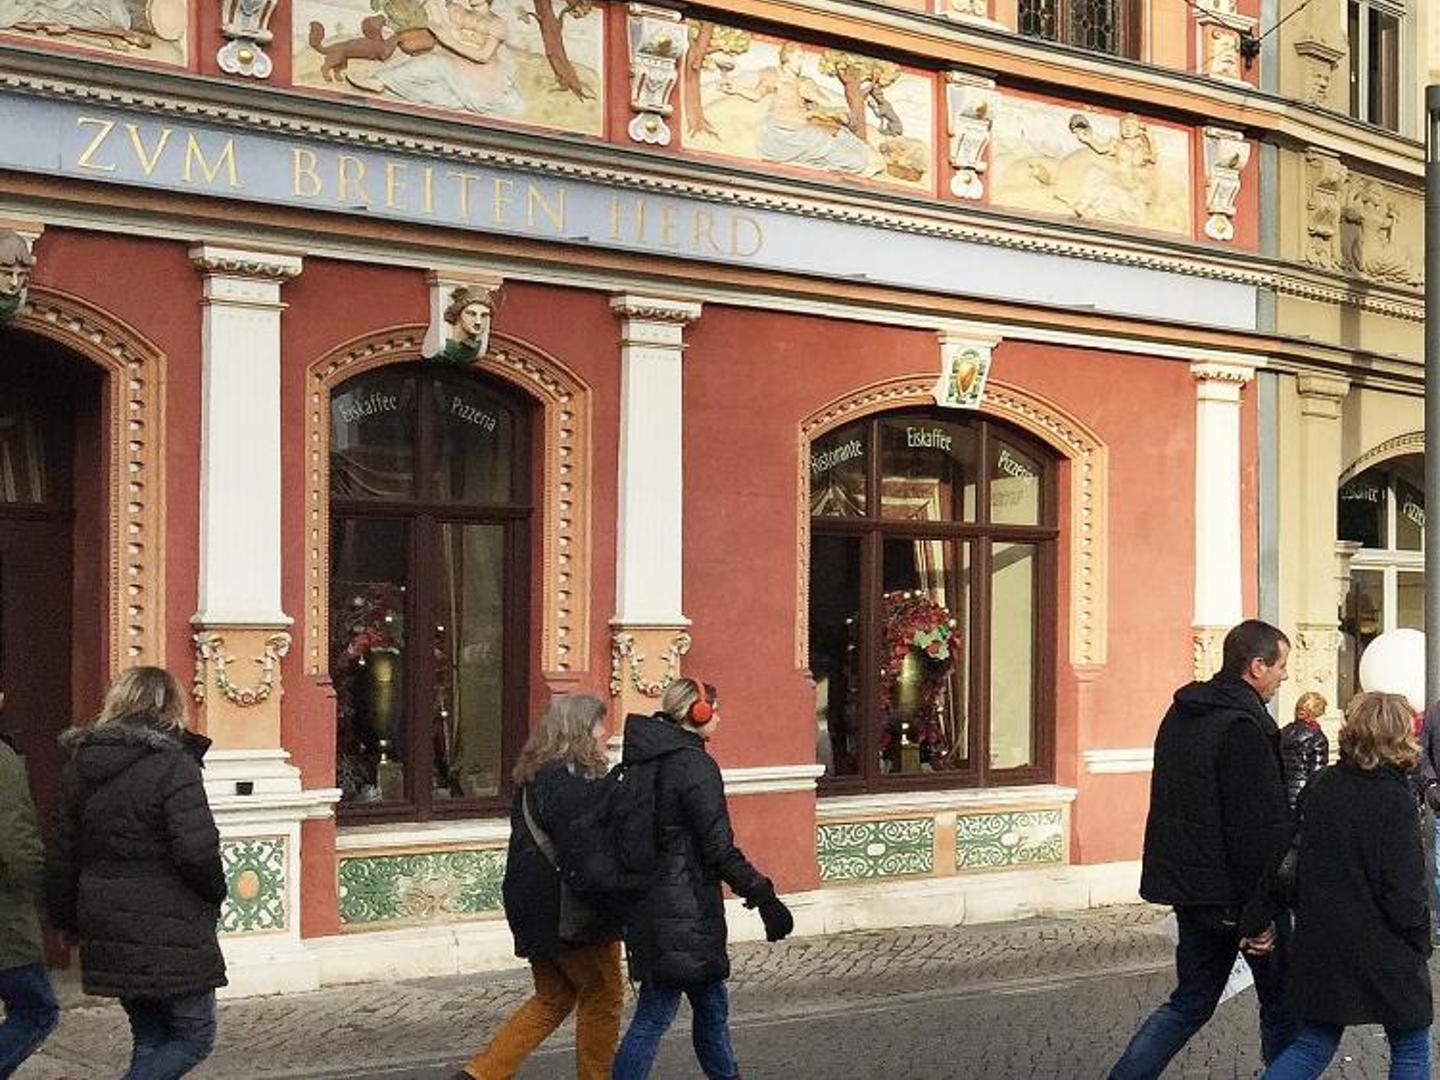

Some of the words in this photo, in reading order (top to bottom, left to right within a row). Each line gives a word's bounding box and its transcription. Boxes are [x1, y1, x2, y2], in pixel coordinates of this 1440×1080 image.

[75, 117, 245, 188] ZVM
[290, 148, 572, 237] BREITEN
[610, 194, 765, 258] HERD
[450, 396, 497, 433] Pizzeria
